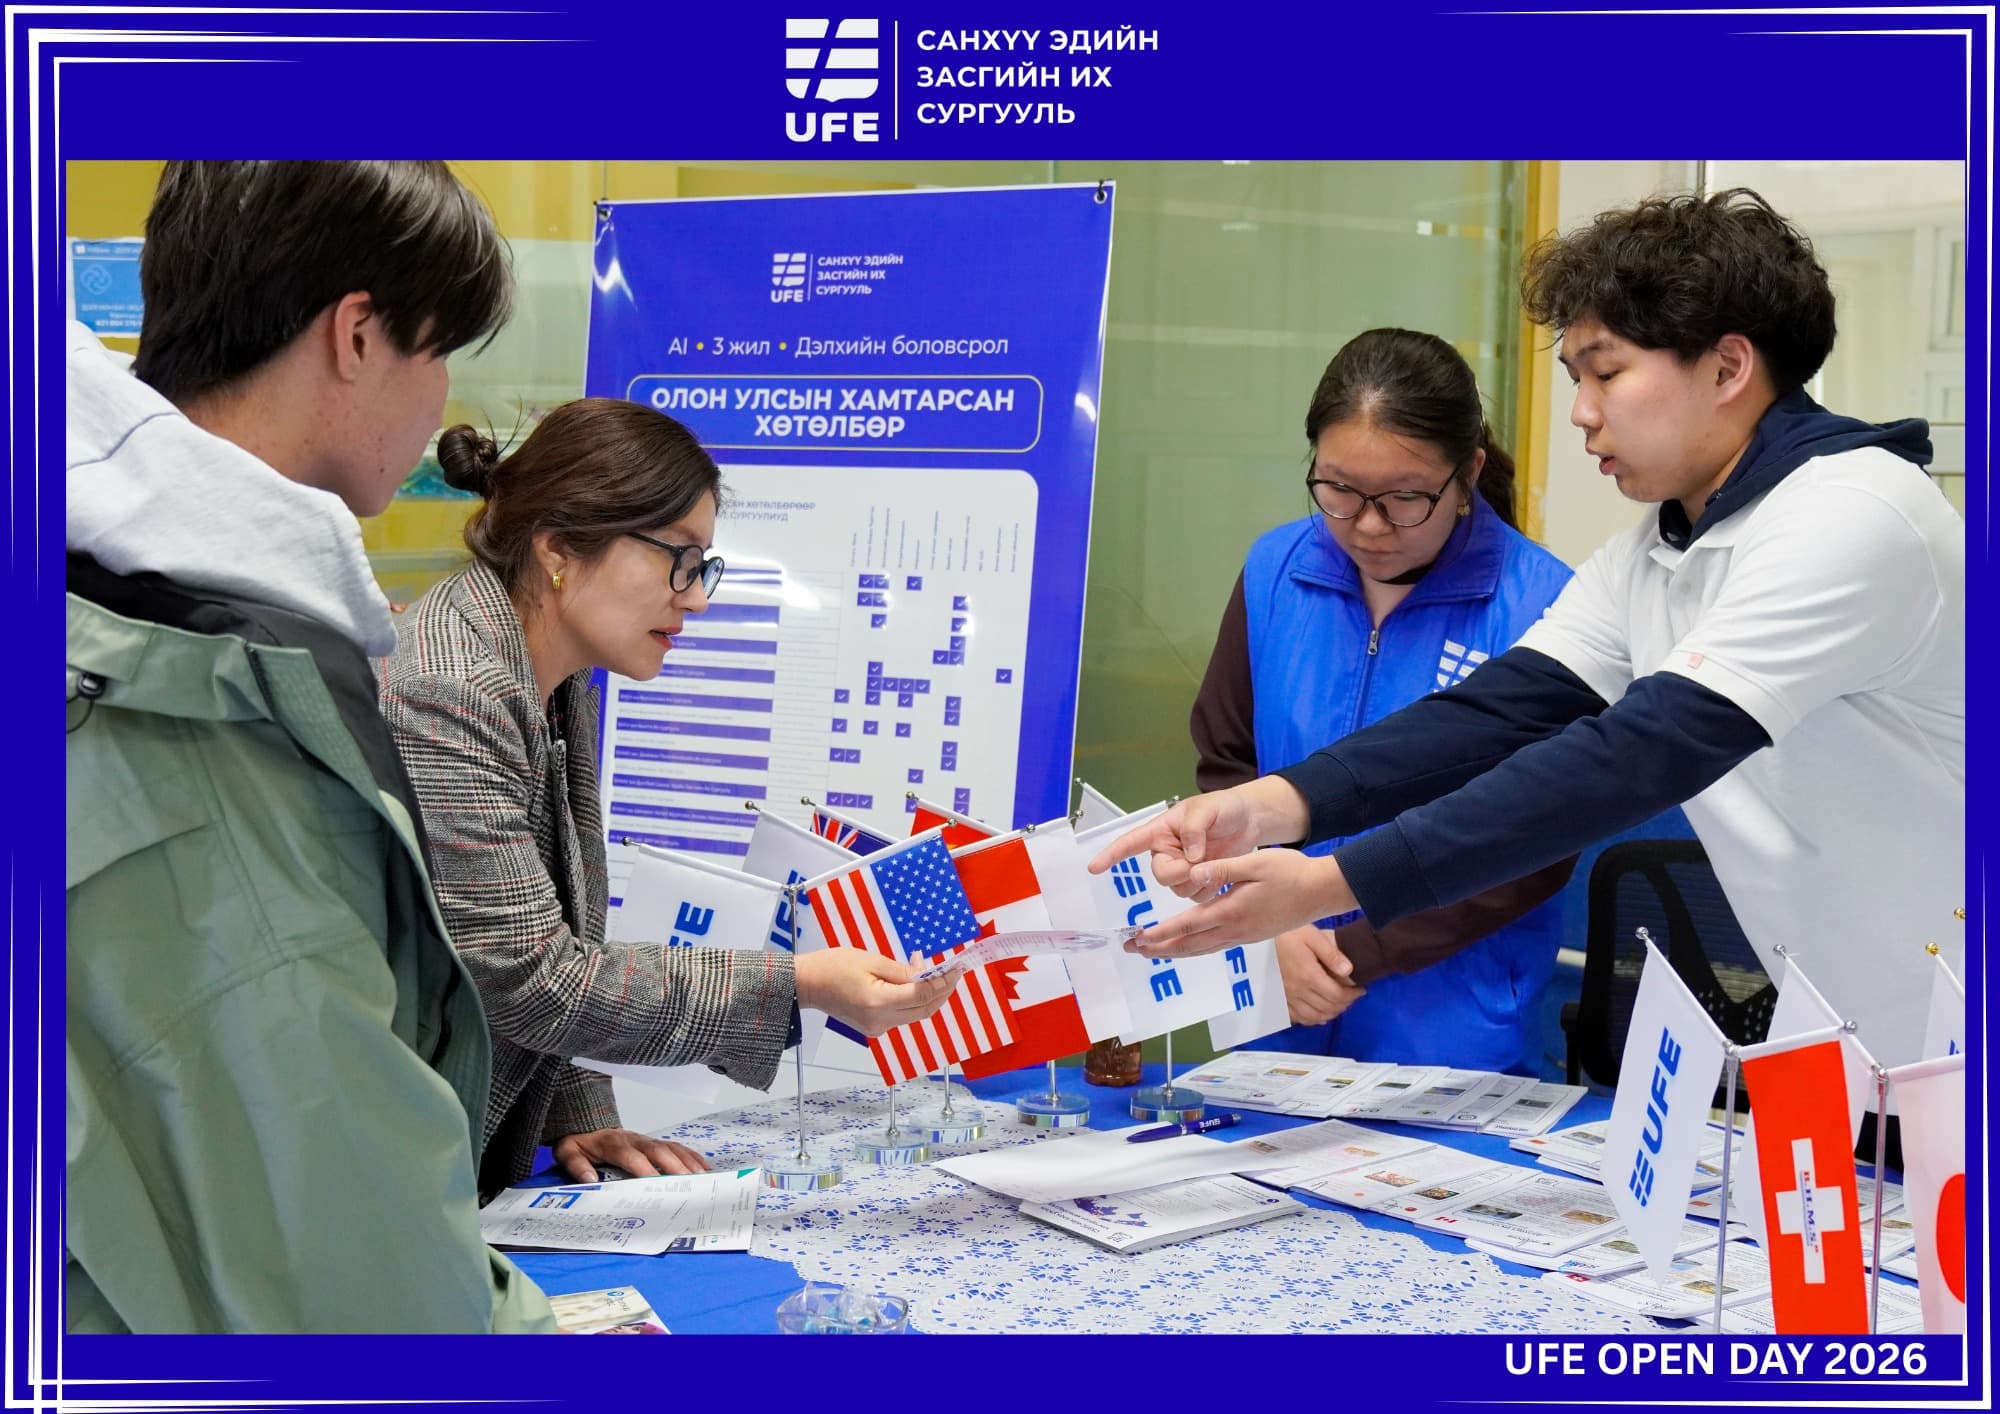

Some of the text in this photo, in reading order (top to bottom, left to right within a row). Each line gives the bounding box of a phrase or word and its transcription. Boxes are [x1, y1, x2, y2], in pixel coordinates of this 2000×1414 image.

[864, 253, 904, 266] ЭДИЙН
[817, 269, 886, 281] ЗАСГИЙН ИХ
[770, 289, 804, 303] UFE
[816, 285, 872, 295] СУРГУУЛЬ
[668, 335, 1009, 359] AI 3 жил Дэлхийн боловсрол
[651, 387, 1014, 411] ОЛОН УЛСЫН ХАМТАРСАН
[754, 414, 905, 437] ХӨТӨЛБӨР
[1641, 1026, 1682, 1155] UFE
